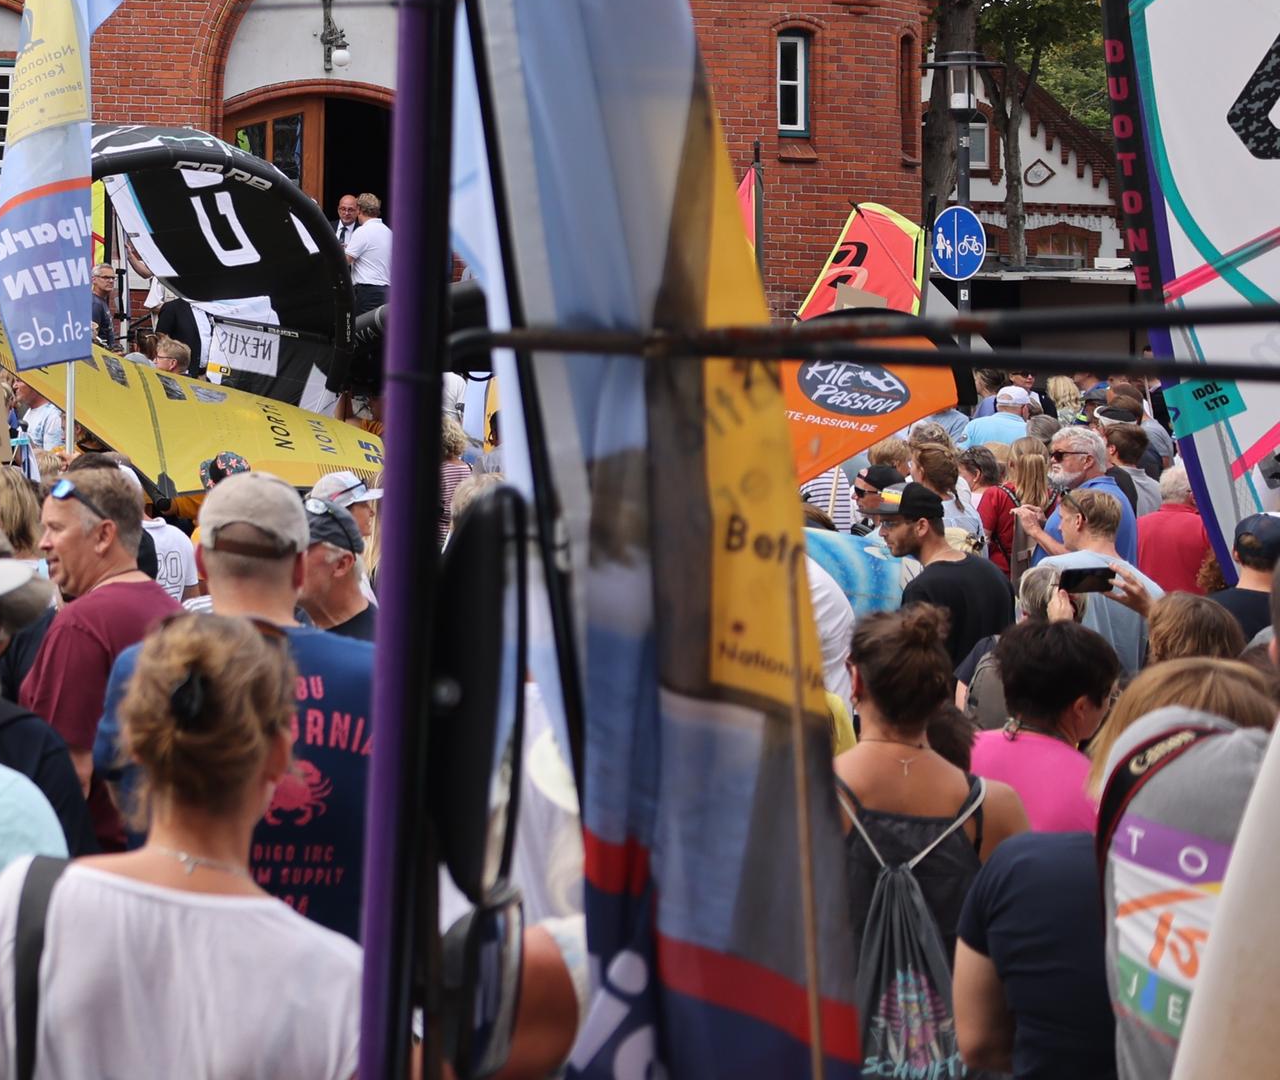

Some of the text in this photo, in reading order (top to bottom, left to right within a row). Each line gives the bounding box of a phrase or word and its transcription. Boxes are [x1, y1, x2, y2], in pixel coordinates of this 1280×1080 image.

[173, 160, 273, 192] CORE
[1104, 39, 1153, 290] DUOTONE
[1192, 381, 1223, 400] IDOL
[1204, 394, 1230, 411] LTD
[257, 402, 296, 451] NORTH
[310, 419, 338, 456] NOVA
[156, 551, 183, 584] 20
[296, 675, 324, 701] BU
[1129, 730, 1197, 774] Canon
[253, 844, 296, 864] DIGO
[280, 867, 344, 887] SUPPLY
